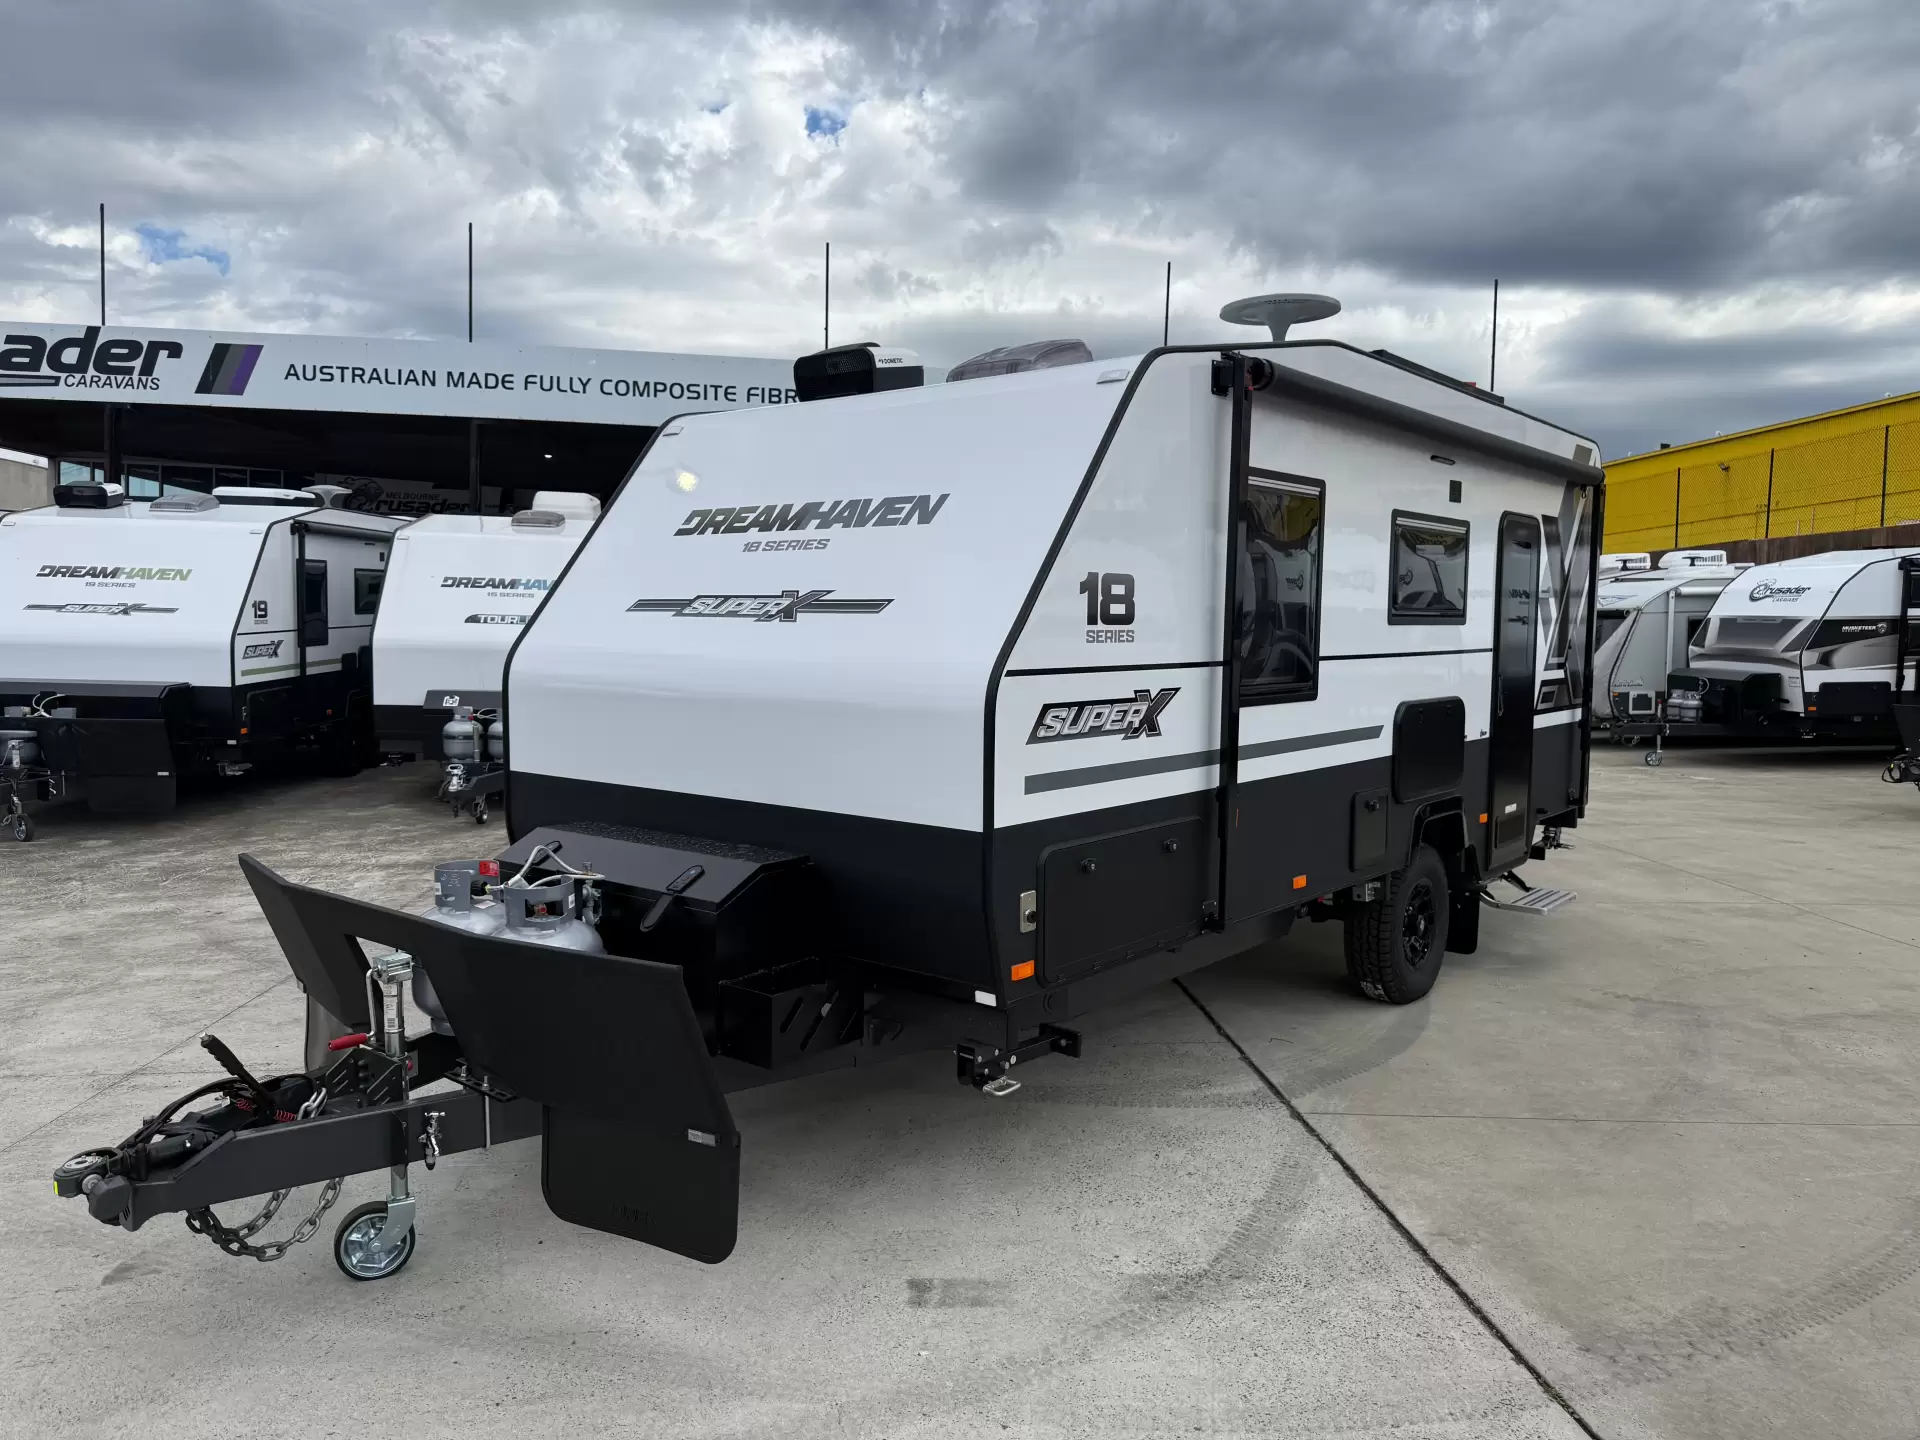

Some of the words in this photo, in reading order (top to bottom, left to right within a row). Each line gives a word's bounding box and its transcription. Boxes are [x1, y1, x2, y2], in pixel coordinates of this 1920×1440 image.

[64, 374, 160, 390] CARAVANS
[284, 363, 436, 387] AUSTRALIAN
[446, 371, 515, 391] MADE
[524, 374, 592, 395] FULLY
[600, 379, 737, 402] COMPOSITE
[386, 490, 441, 500] MELBOURNE
[673, 493, 951, 537] DREAMHAVEN
[742, 541, 760, 553] 18
[762, 538, 831, 552] SERIES
[36, 565, 193, 581] DREAMHAVEN
[1079, 571, 1136, 626] 18
[252, 600, 268, 619] 19
[1085, 629, 1135, 644] SERIES
[1035, 687, 1183, 739] SUPERX
